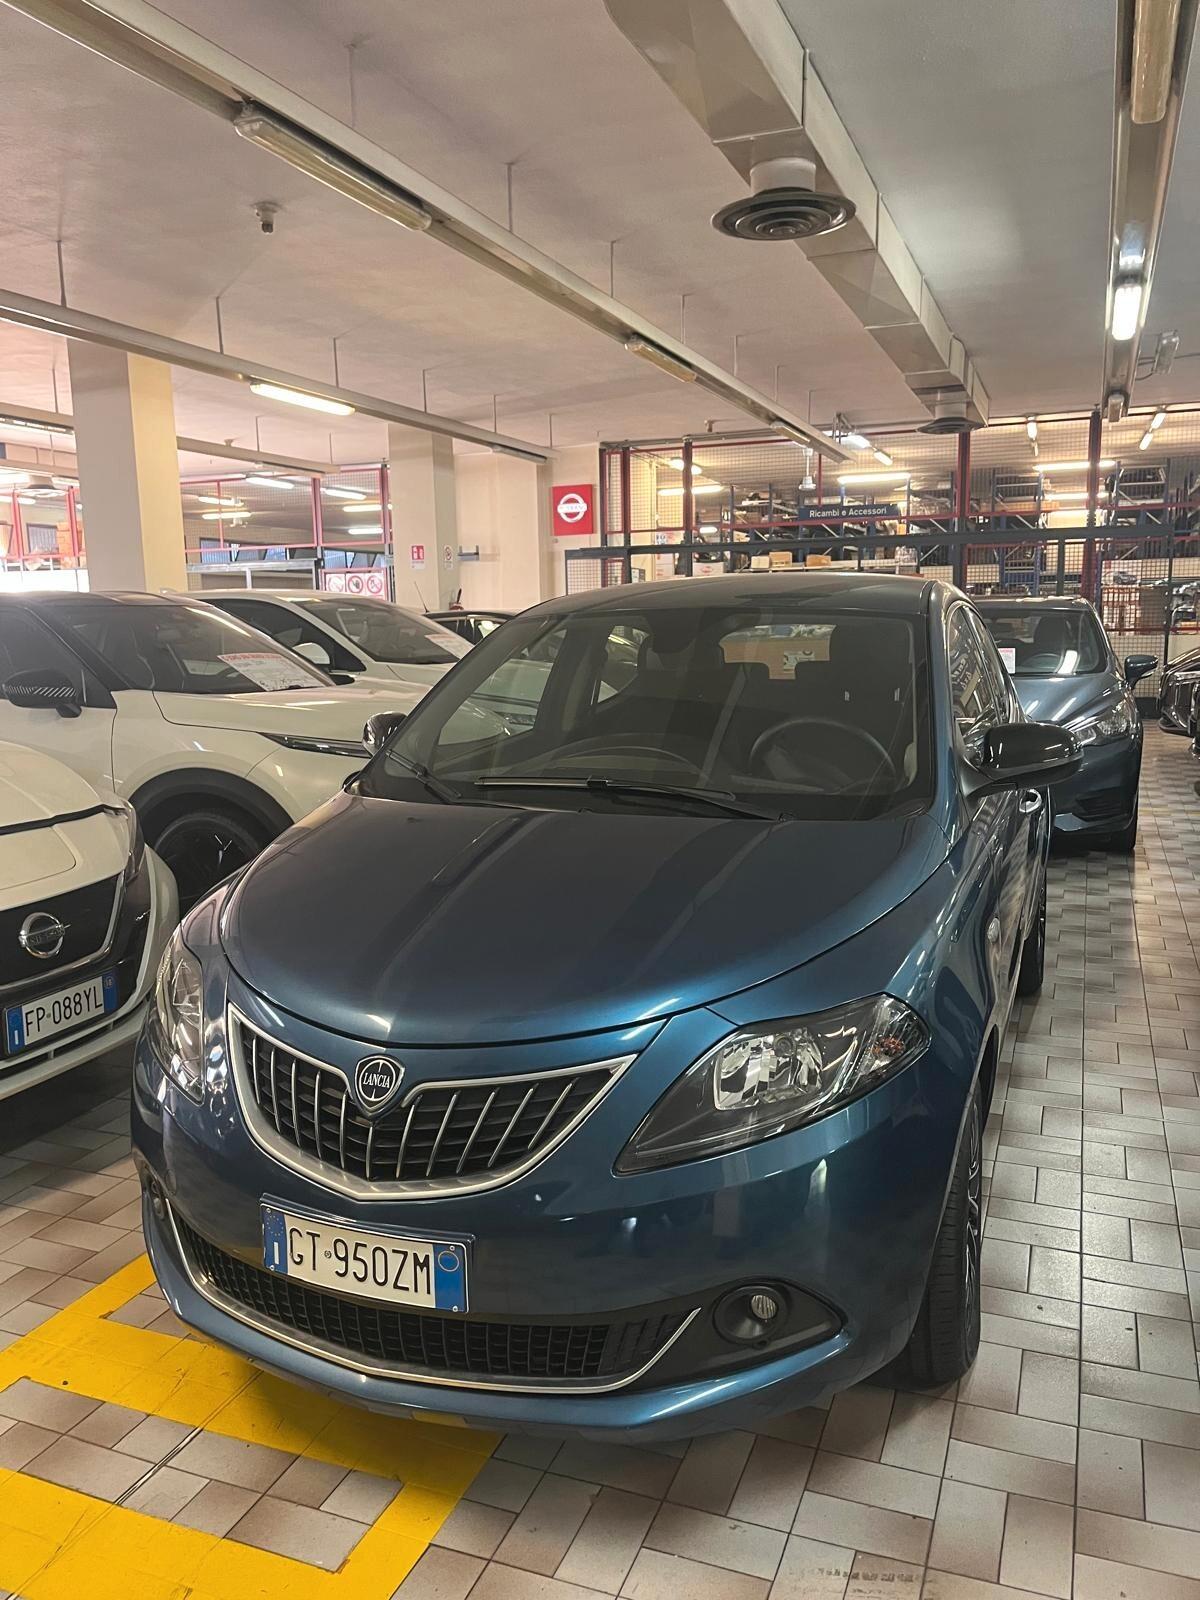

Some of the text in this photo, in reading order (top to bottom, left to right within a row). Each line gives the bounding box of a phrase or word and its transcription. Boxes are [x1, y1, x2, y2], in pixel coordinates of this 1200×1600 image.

[809, 509, 839, 518] Ricambi
[848, 507, 887, 516] Accessori
[25, 986, 103, 1036] FP 088YL
[363, 1072, 391, 1089] LANCIA
[289, 1227, 431, 1295] GT 950ZM
